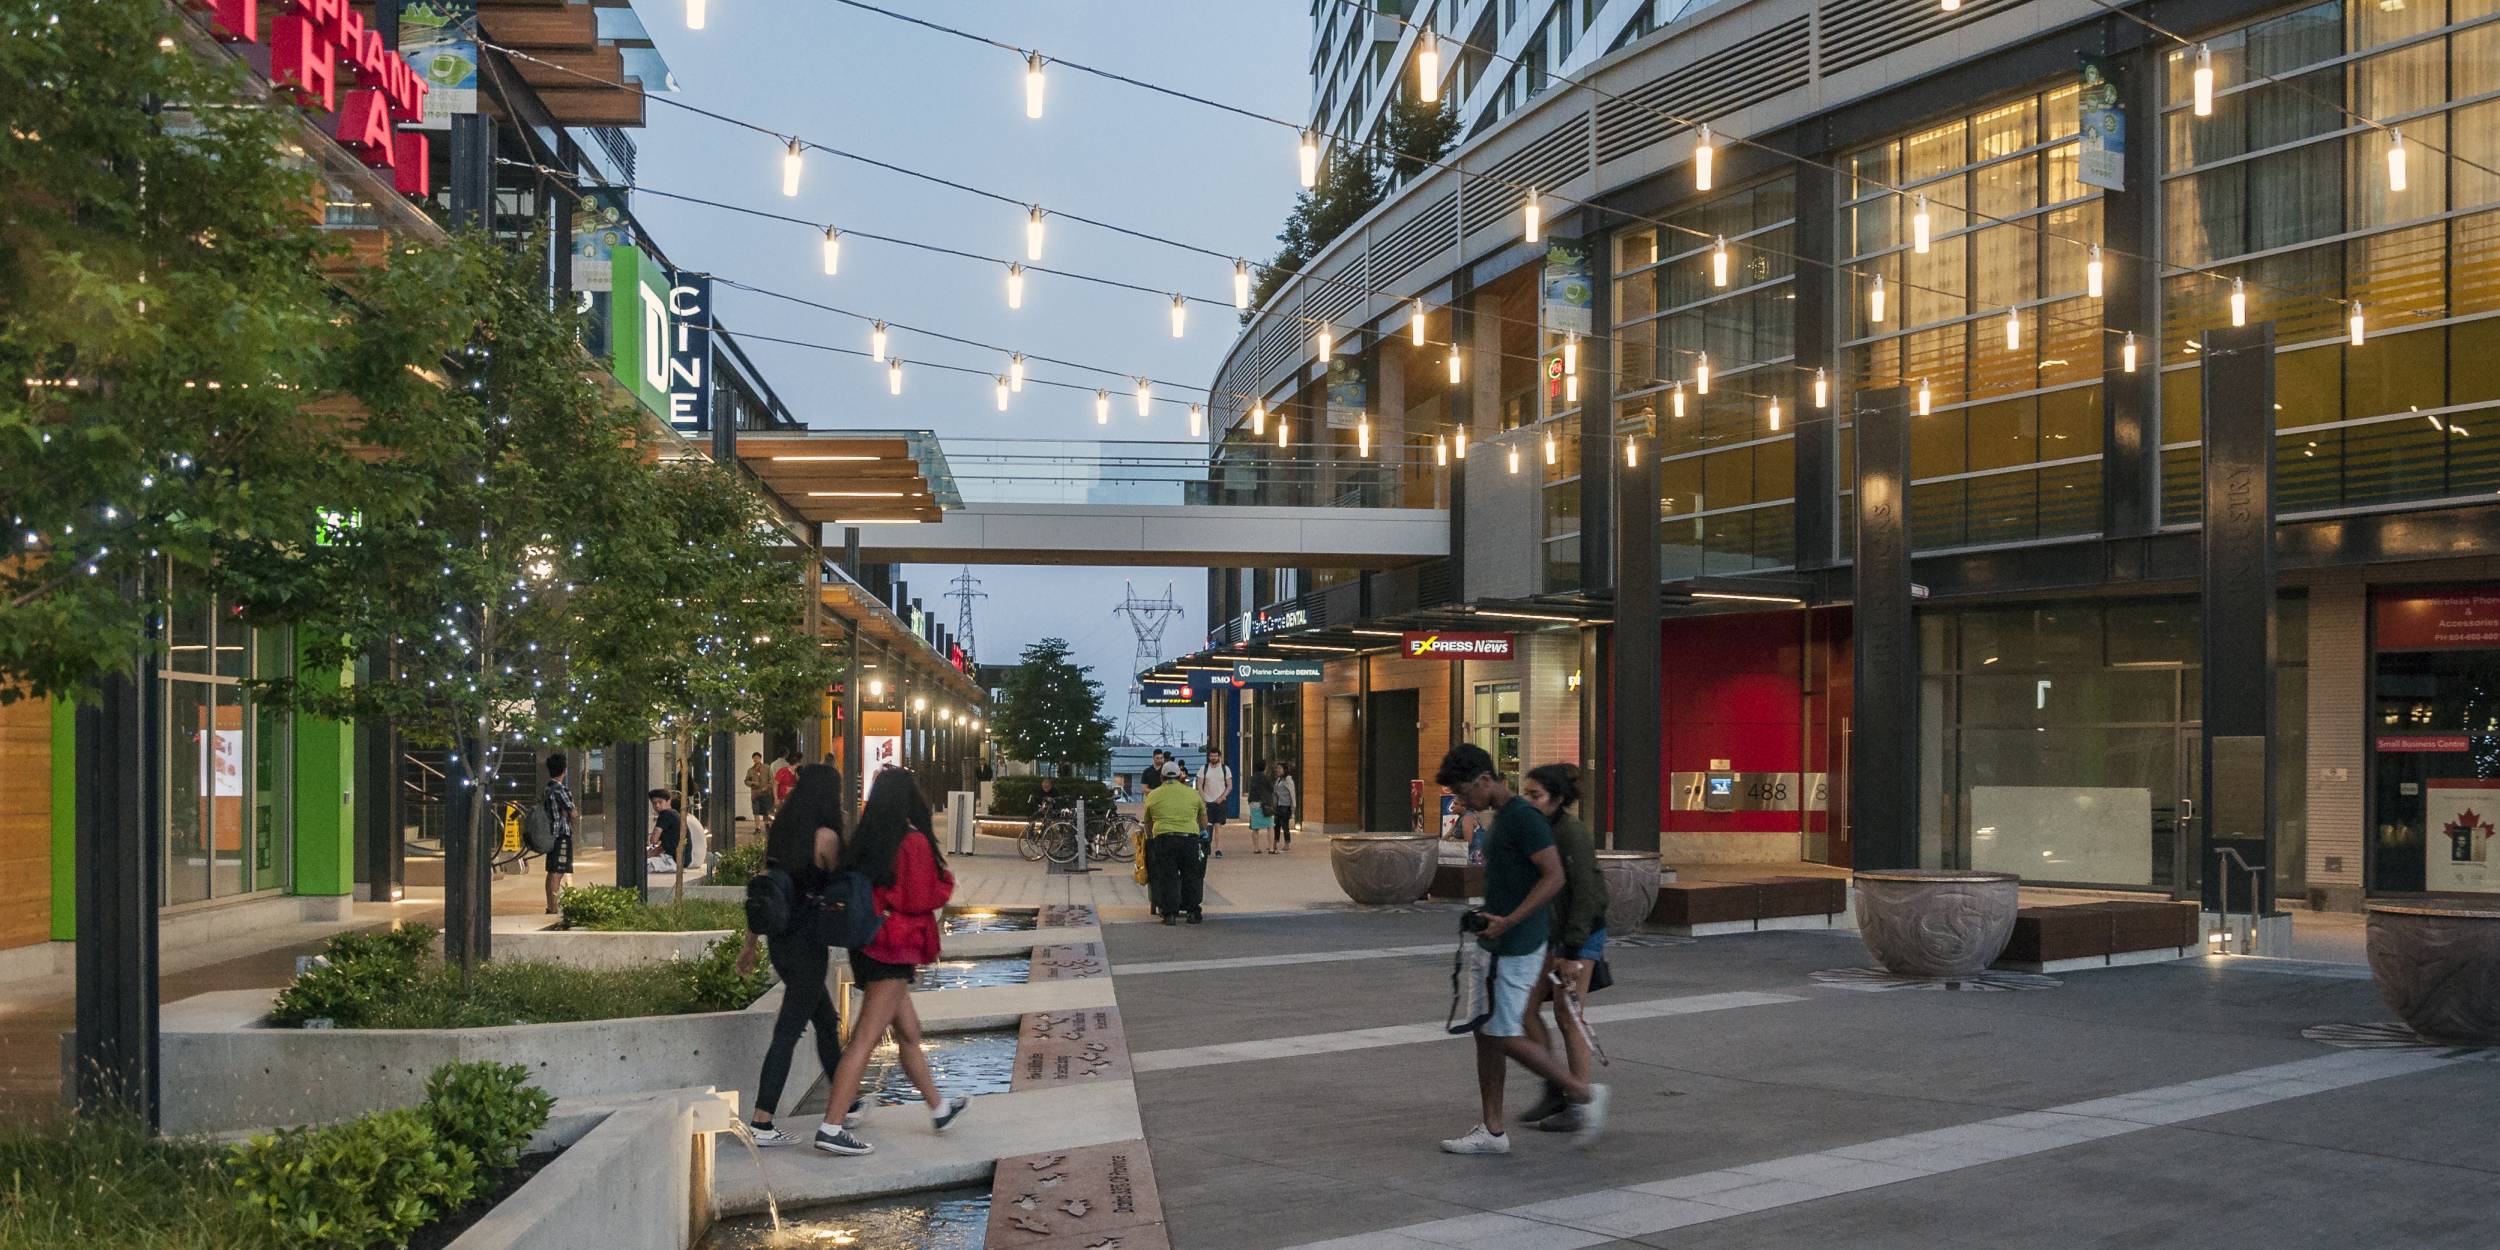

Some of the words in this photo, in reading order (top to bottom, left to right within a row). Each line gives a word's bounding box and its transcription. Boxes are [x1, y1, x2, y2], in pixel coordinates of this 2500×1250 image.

[297, 0, 428, 123] PHANT
[669, 286, 700, 437] CINE
[2473, 597, 2500, 605] Phon
[1411, 636, 1473, 655] EXPRESS
[1474, 640, 1509, 653] News
[1211, 676, 1230, 684] BMO
[2379, 740, 2400, 748] Small
[2401, 740, 2436, 748] Business
[2438, 740, 2465, 748] Centre
[1747, 783, 1786, 800] 488
